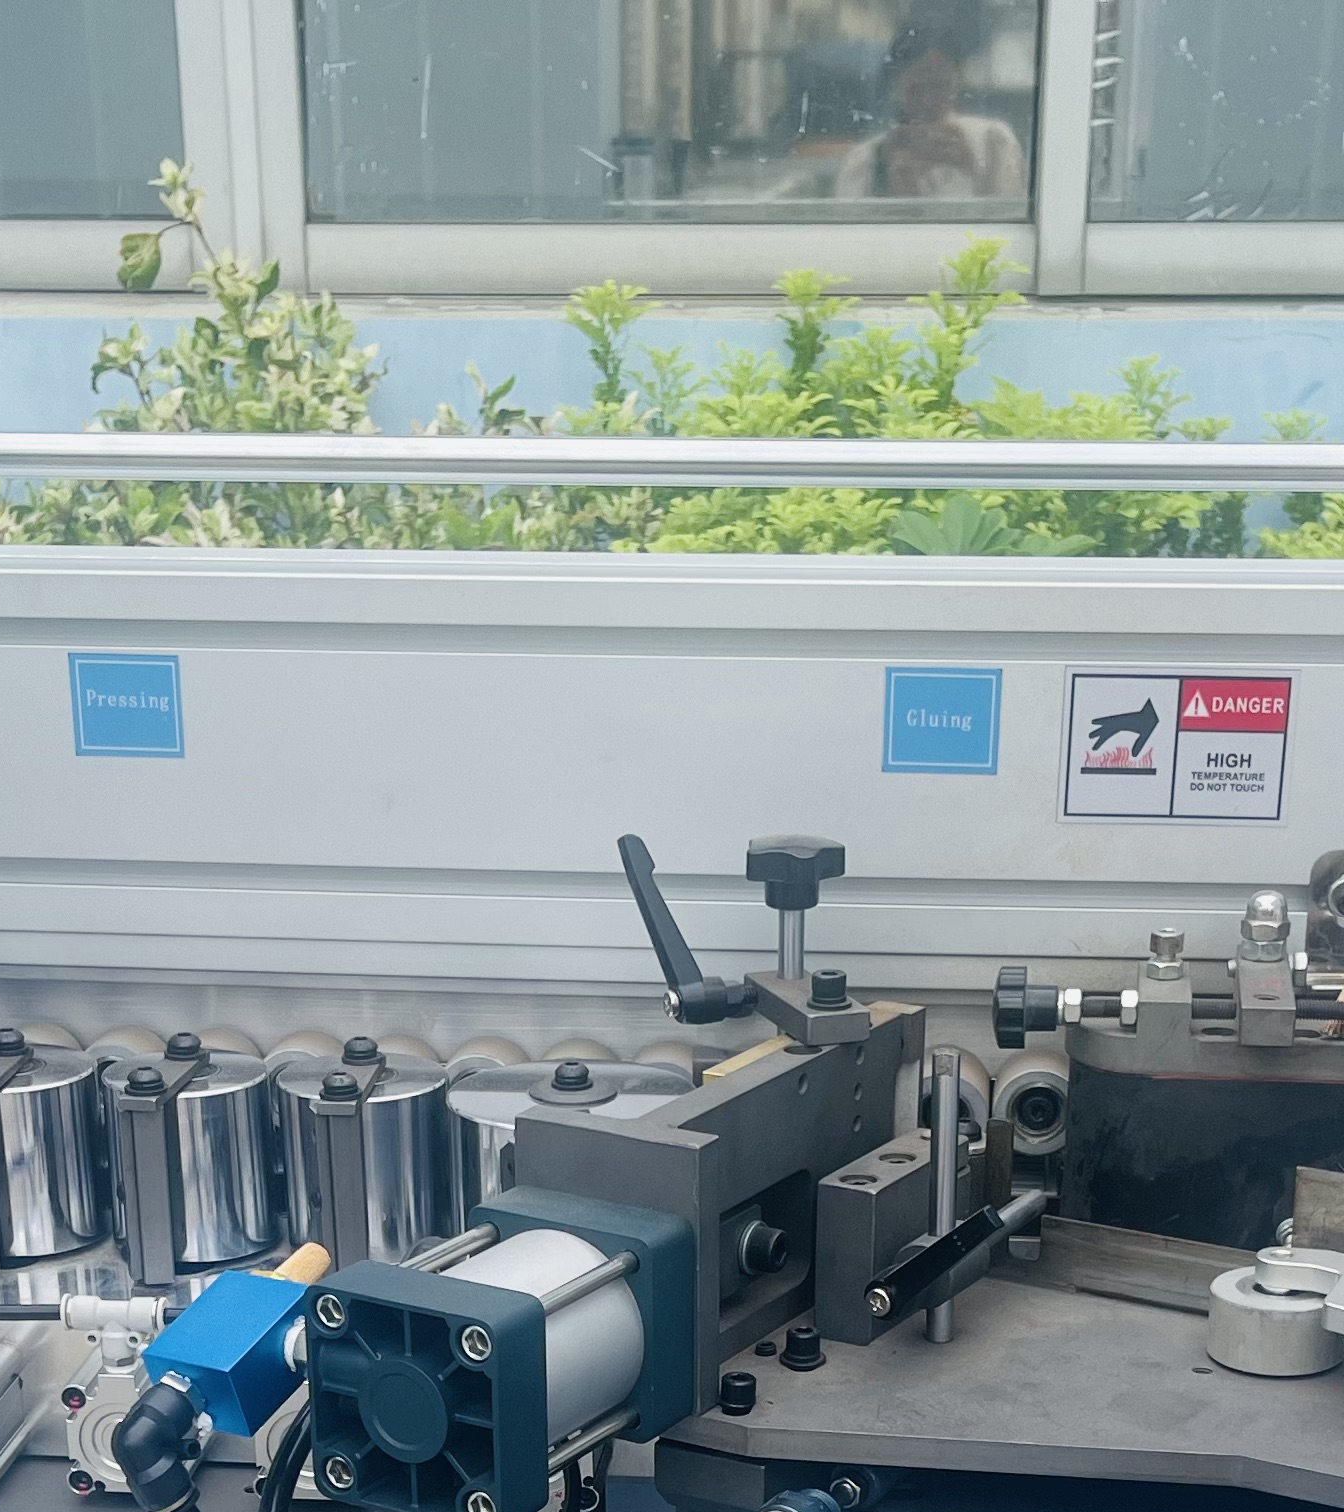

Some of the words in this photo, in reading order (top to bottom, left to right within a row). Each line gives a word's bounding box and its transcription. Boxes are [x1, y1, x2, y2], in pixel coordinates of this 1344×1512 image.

[85, 688, 170, 713] Pressing
[1211, 696, 1285, 714] DANGER
[906, 707, 972, 732] Gluing
[1206, 752, 1252, 768] HIGH
[1191, 771, 1265, 782] TEMPERATURE
[1190, 783, 1205, 791] DO
[1206, 783, 1227, 792] NOT
[1230, 783, 1265, 793] TOUCH
